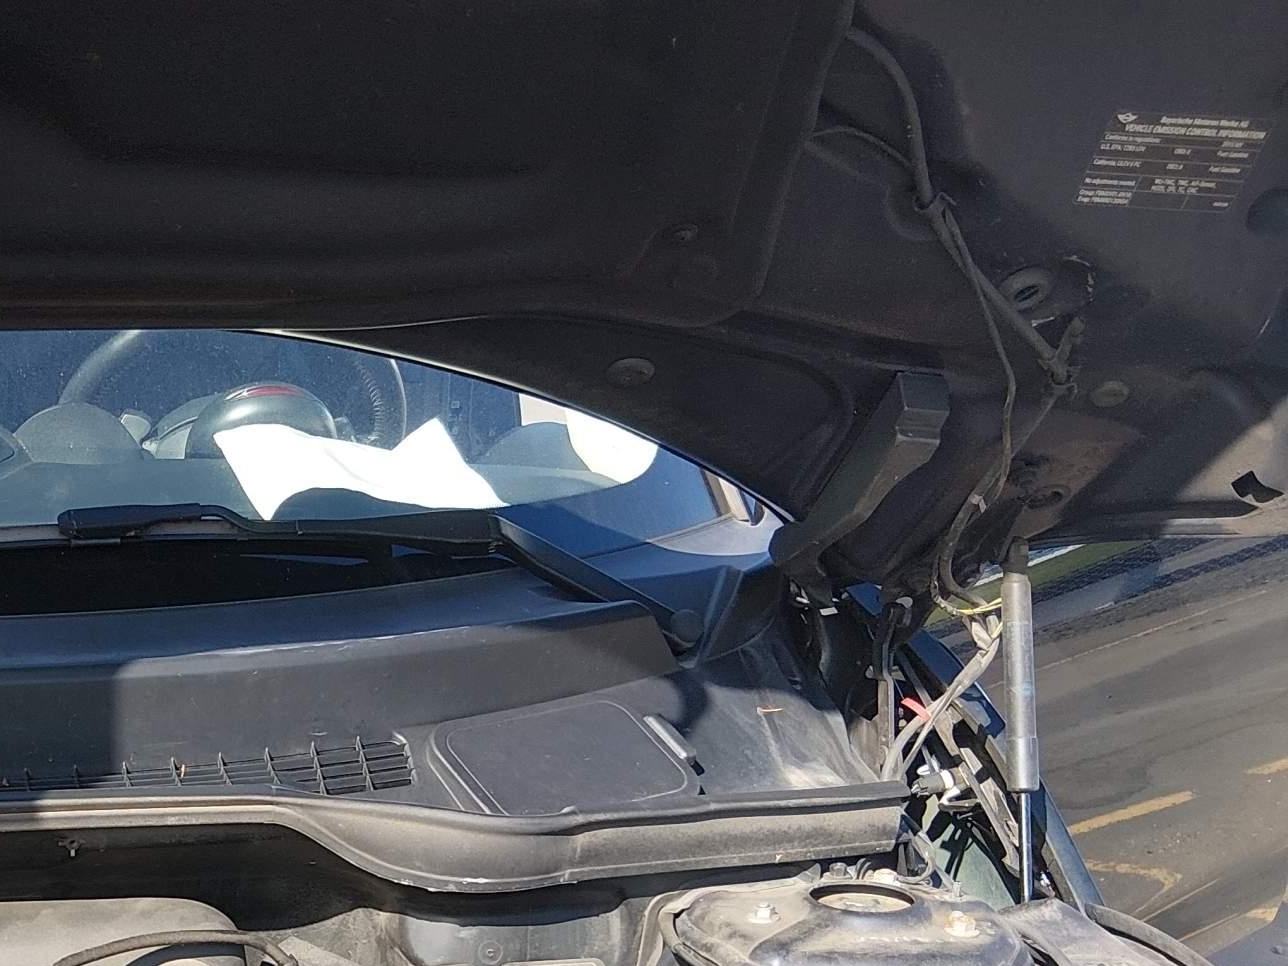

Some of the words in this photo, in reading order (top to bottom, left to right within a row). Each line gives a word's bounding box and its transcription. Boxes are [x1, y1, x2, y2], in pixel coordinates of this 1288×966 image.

[1124, 123, 1154, 132] VEHICLE
[1153, 125, 1187, 134] EMISSION
[1186, 127, 1218, 136] CONTROL
[1218, 129, 1266, 139] INFORMATION
